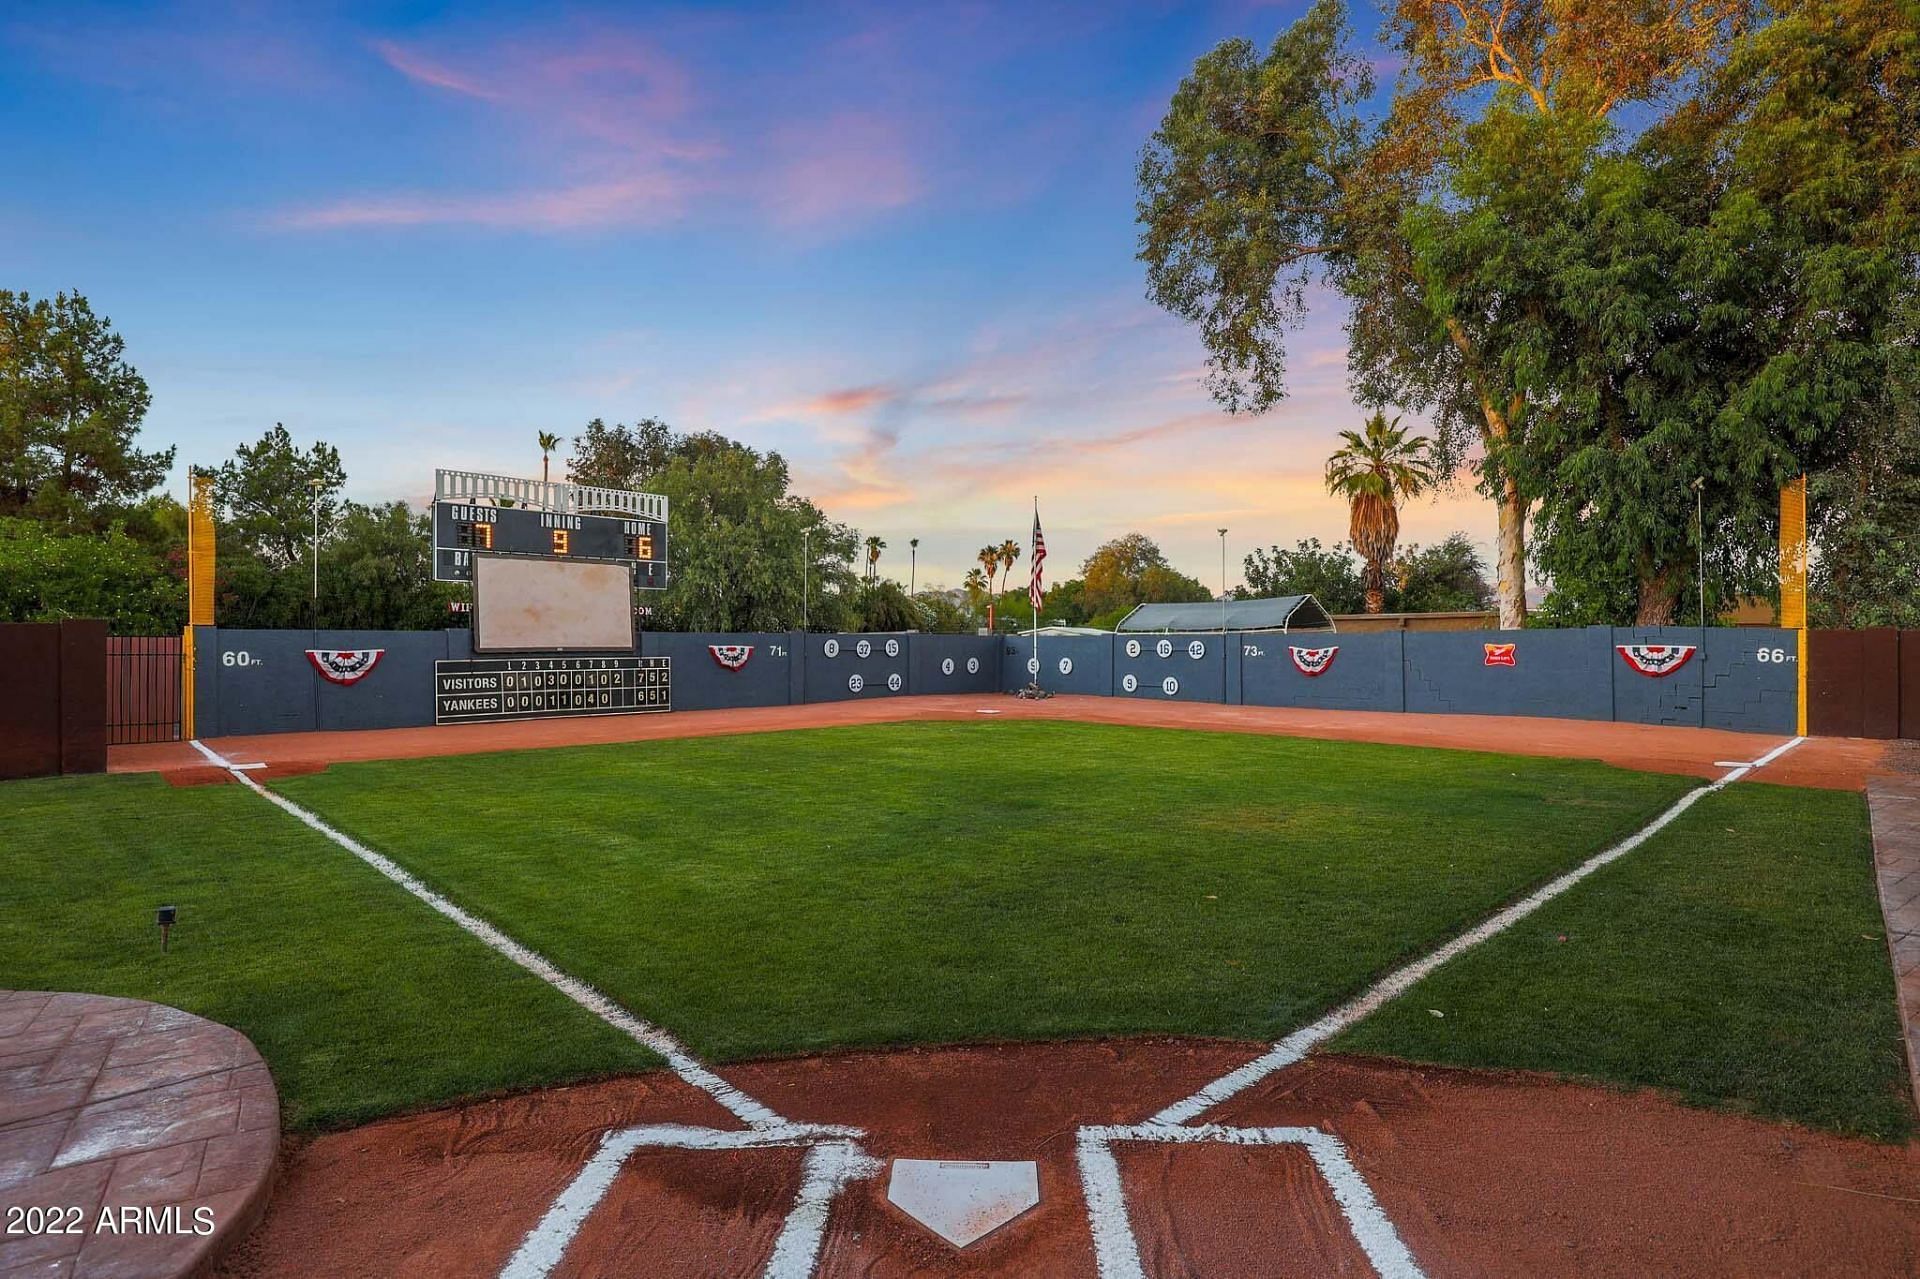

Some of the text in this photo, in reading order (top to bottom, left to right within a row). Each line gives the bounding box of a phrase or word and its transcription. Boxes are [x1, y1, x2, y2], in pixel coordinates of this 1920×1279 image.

[451, 505, 497, 523] GUESTS
[540, 513, 581, 530] INNING
[623, 521, 651, 536] HOME
[475, 524, 491, 549] 7
[553, 529, 568, 554] 9
[638, 535, 652, 559] 6
[769, 645, 782, 657] 71
[858, 643, 869, 655] 37
[887, 643, 897, 654] 15
[1159, 643, 1170, 654] 16
[1189, 644, 1202, 655] 42
[1243, 645, 1258, 657] 73
[1756, 647, 1785, 663] 66
[222, 651, 250, 666] 60
[507, 661, 512, 670] 1
[521, 661, 527, 670] 2
[535, 661, 540, 670] 3
[549, 660, 554, 669] 4
[561, 660, 567, 669] 5
[575, 660, 581, 669] 6
[589, 660, 594, 669] 7
[601, 660, 606, 669] 8
[614, 659, 619, 668] 9
[443, 672, 668, 690] VISITORS 0 1 0 3 0 0 1 0 2 7 5 2
[850, 677, 900, 689] 23 44
[1165, 680, 1175, 692] 10
[443, 690, 667, 711] YANKEES 0 0 0 1 1 0 4 0 6 5 1
